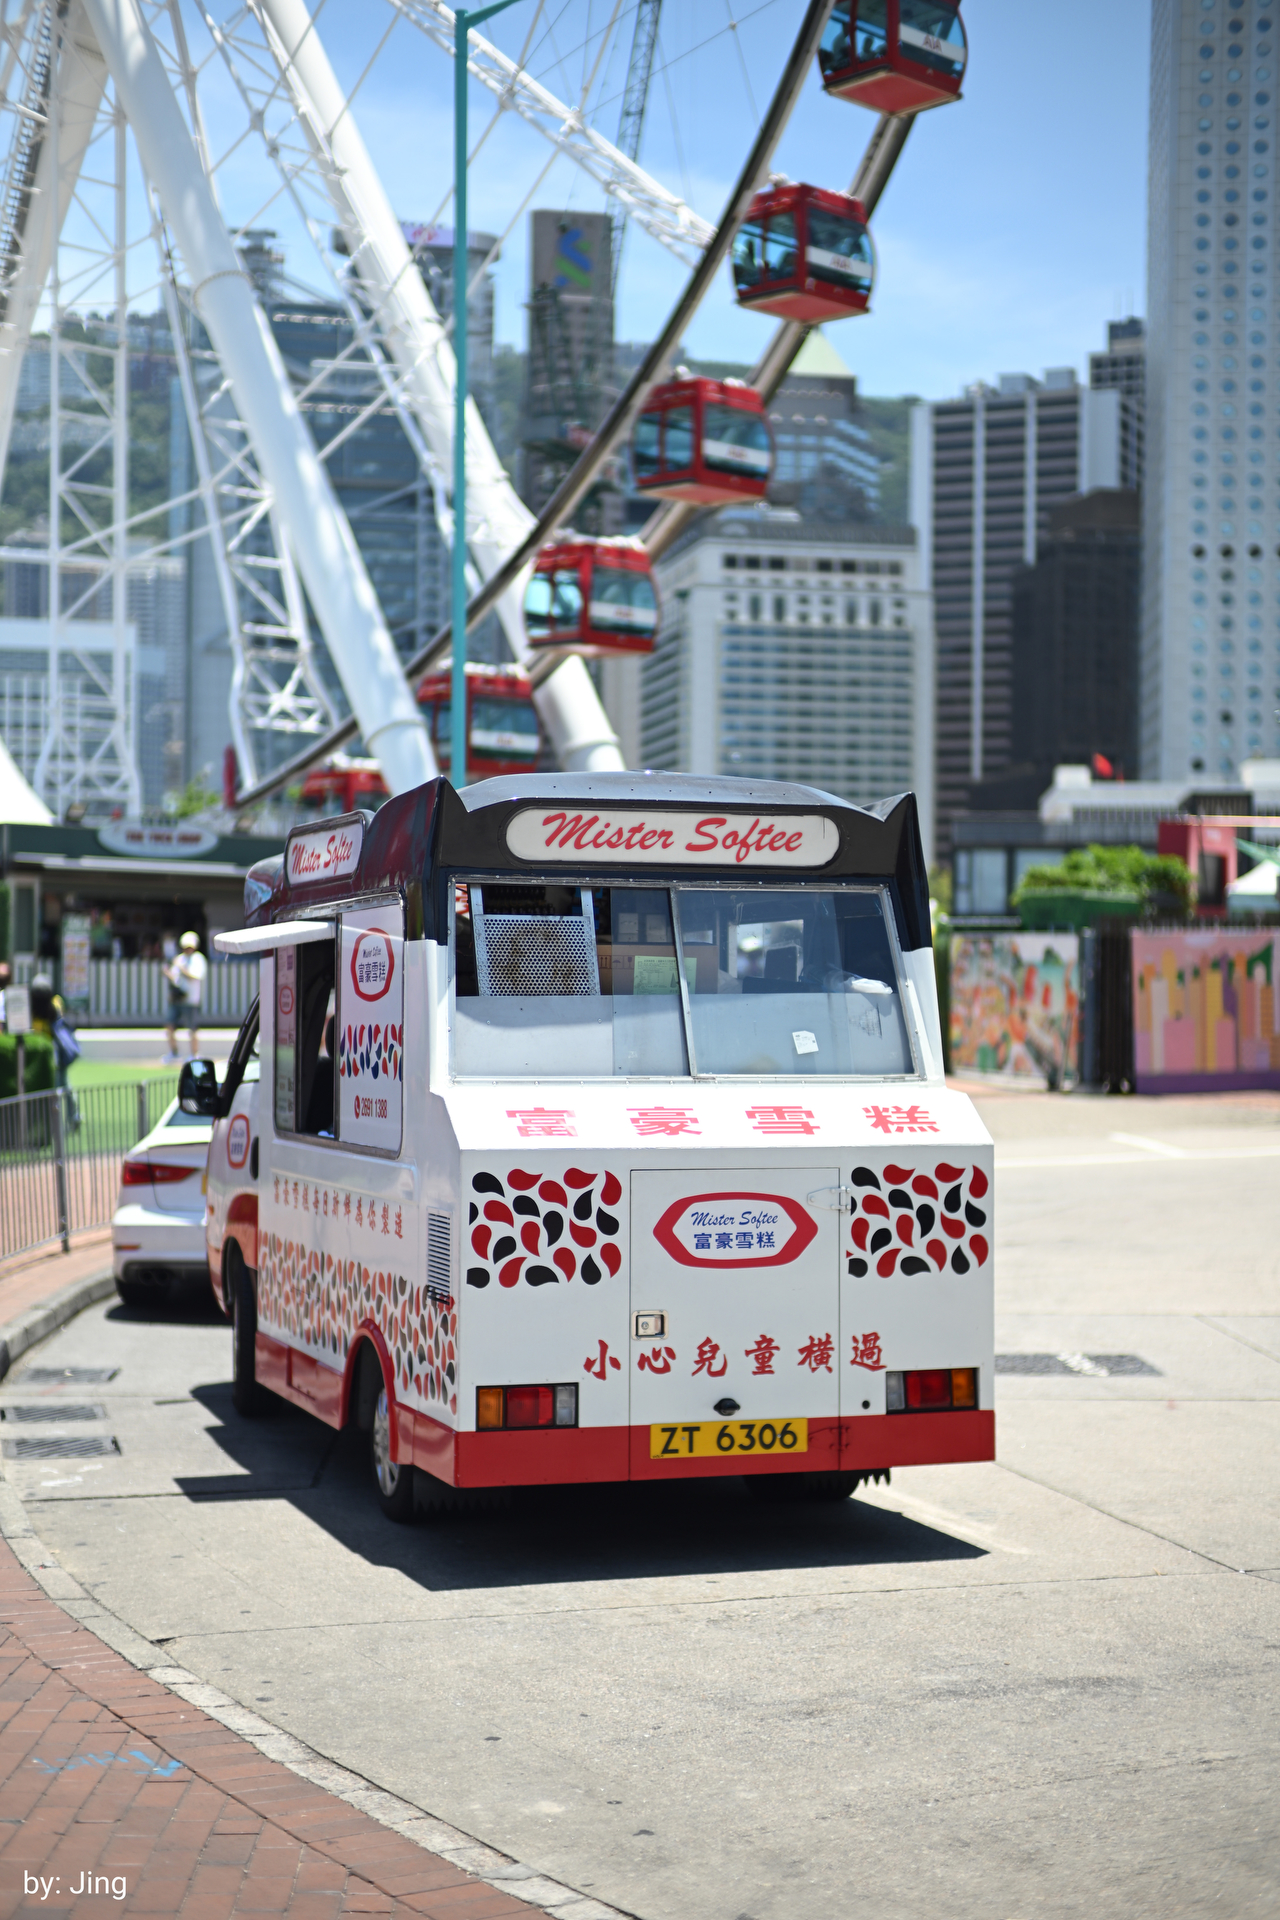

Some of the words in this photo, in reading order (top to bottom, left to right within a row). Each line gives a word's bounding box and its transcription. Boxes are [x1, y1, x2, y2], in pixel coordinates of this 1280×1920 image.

[542, 812, 675, 850] Mister
[685, 817, 803, 863] Softee
[292, 843, 321, 876] Mister
[323, 832, 353, 875] Softee
[358, 961, 386, 983] 富豪雪糕
[361, 1097, 373, 1118] 2691
[375, 1098, 388, 1119] 1388
[505, 1105, 942, 1138] 富豪雪糕
[691, 1211, 735, 1227] Mister
[738, 1210, 779, 1229] Softee
[693, 1231, 776, 1250] 富豪雪糕
[660, 1426, 701, 1455] ZT
[716, 1422, 798, 1452] 6306
